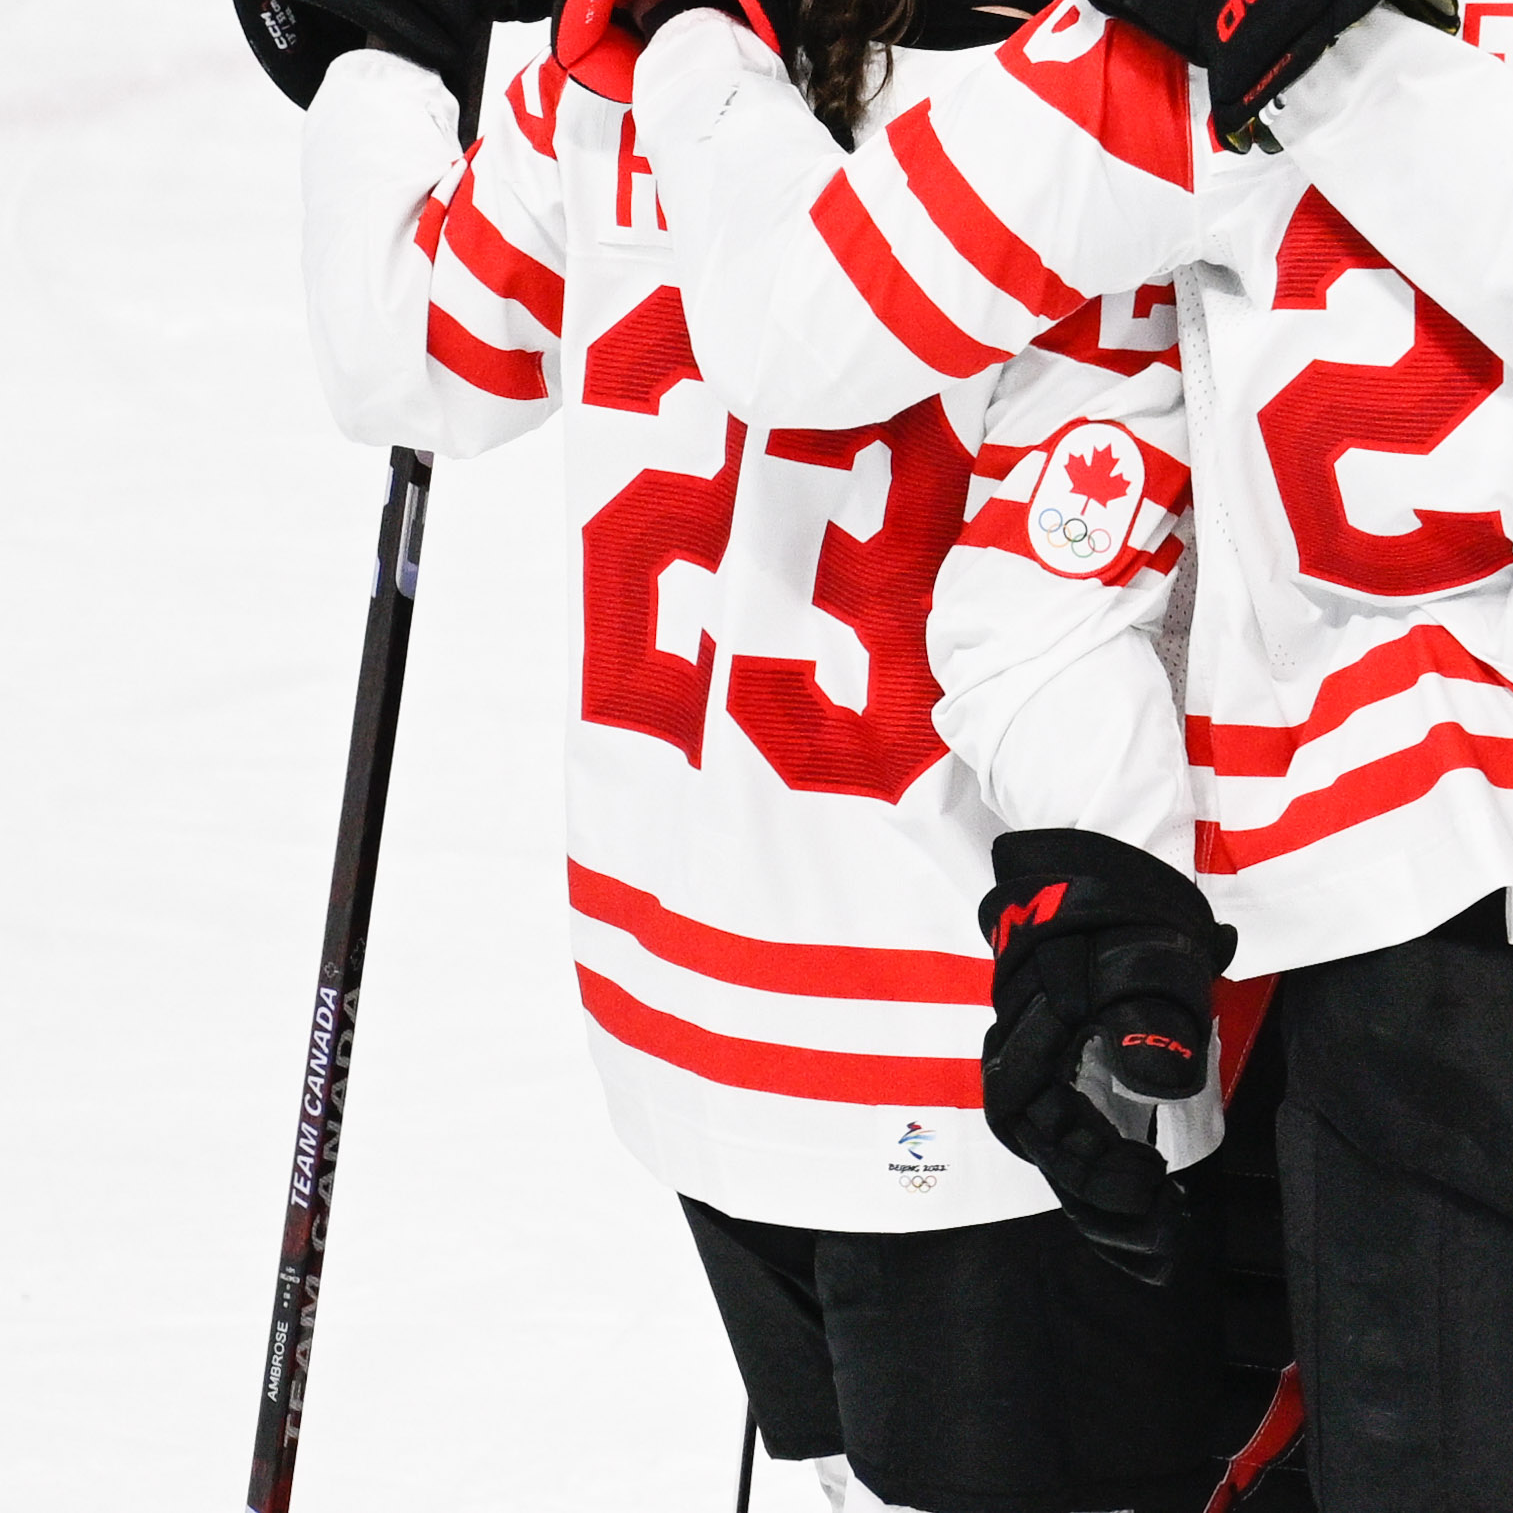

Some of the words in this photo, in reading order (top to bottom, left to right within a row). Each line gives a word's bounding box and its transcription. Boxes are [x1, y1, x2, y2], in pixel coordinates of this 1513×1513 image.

[581, 284, 978, 807] 23
[303, 986, 339, 1119] CANADA
[1121, 1032, 1193, 1060] CCM
[290, 1121, 320, 1210] TEAM
[887, 1163, 920, 1173] BEIJING
[266, 1320, 289, 1402] AMBROSE
